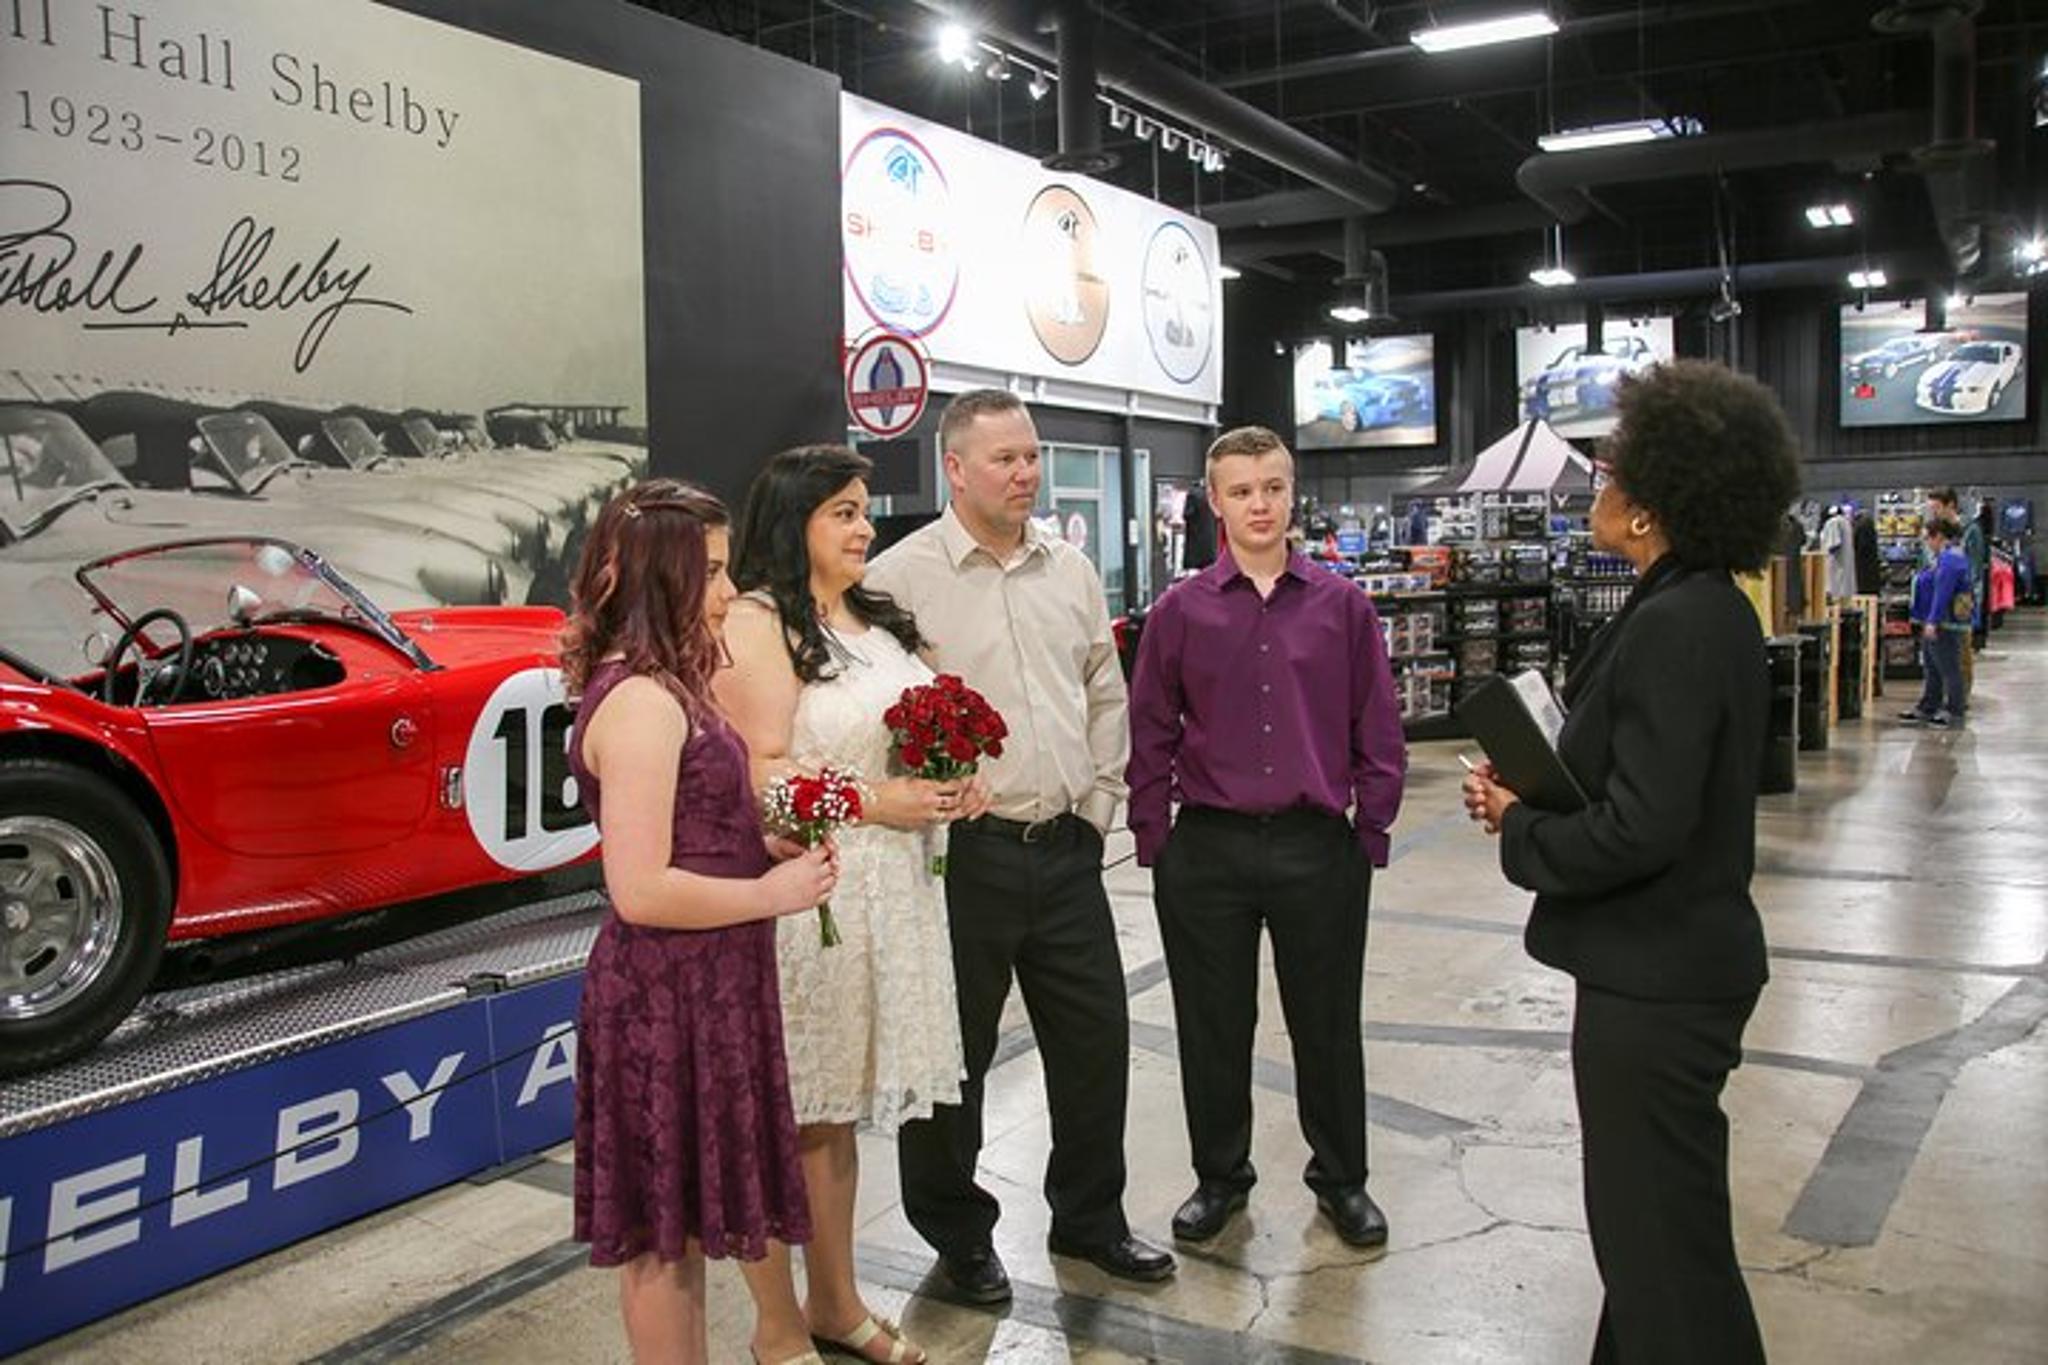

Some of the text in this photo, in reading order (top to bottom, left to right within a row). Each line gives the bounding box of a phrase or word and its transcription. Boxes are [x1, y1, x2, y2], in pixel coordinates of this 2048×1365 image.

[96, 4, 235, 91] Hall
[271, 52, 460, 149] Shelby
[187, 216, 414, 373] Shelby
[0, 1052, 464, 1292] ELBY
